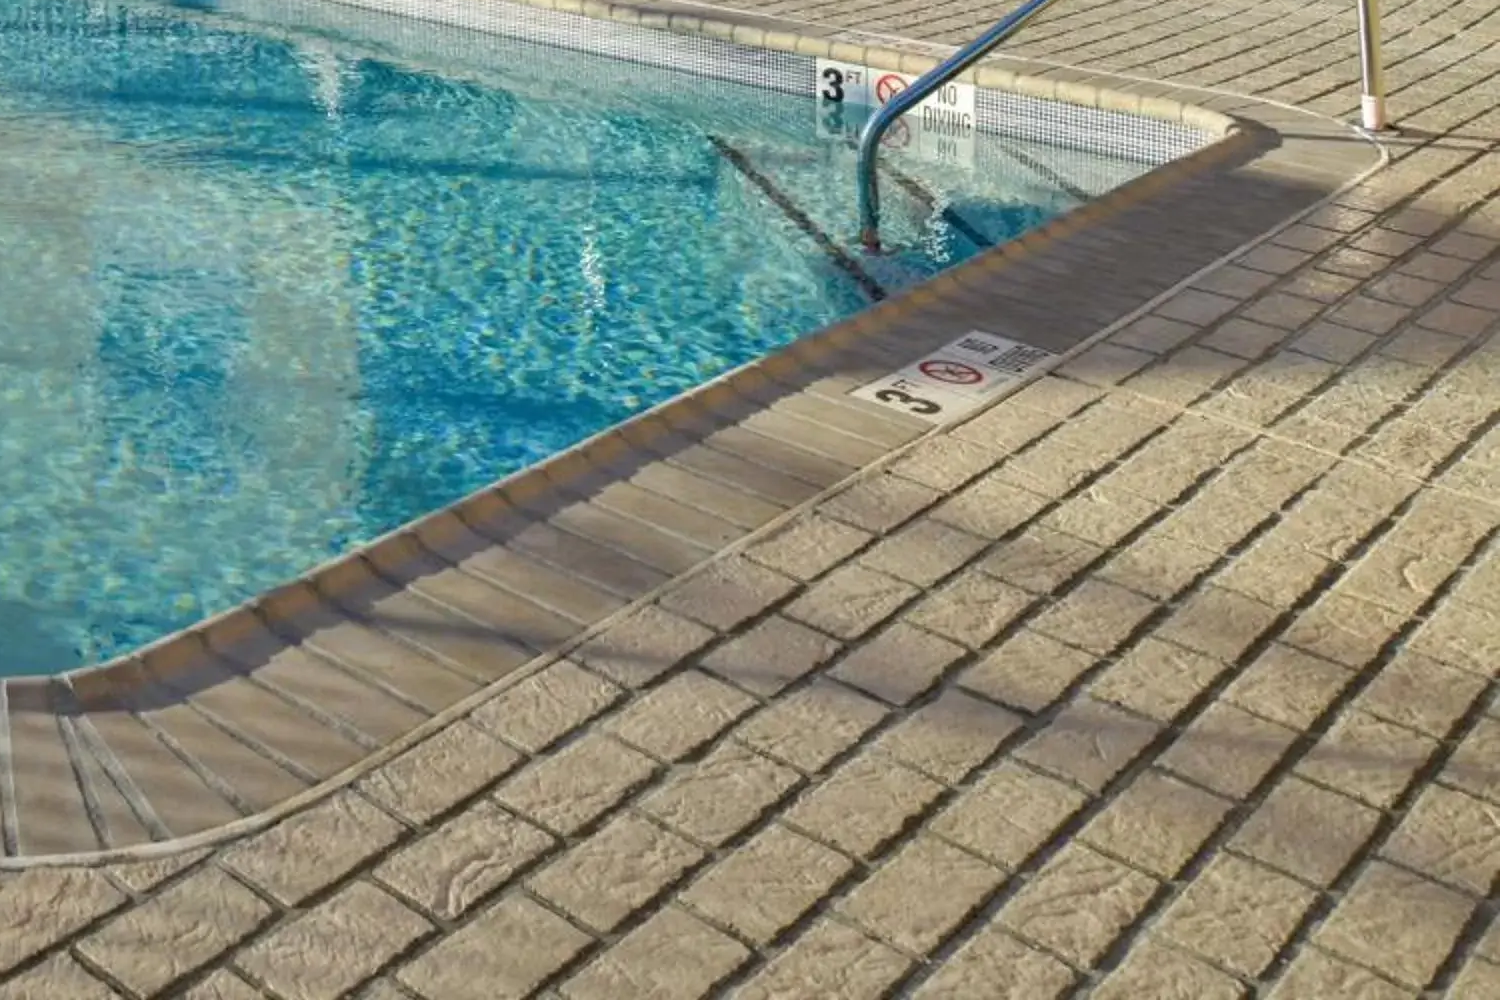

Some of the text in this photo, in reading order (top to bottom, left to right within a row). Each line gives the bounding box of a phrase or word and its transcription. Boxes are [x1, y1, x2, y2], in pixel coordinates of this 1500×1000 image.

[822, 68, 862, 102] 3 FT
[937, 85, 957, 106] NO
[875, 389, 941, 415] 3
